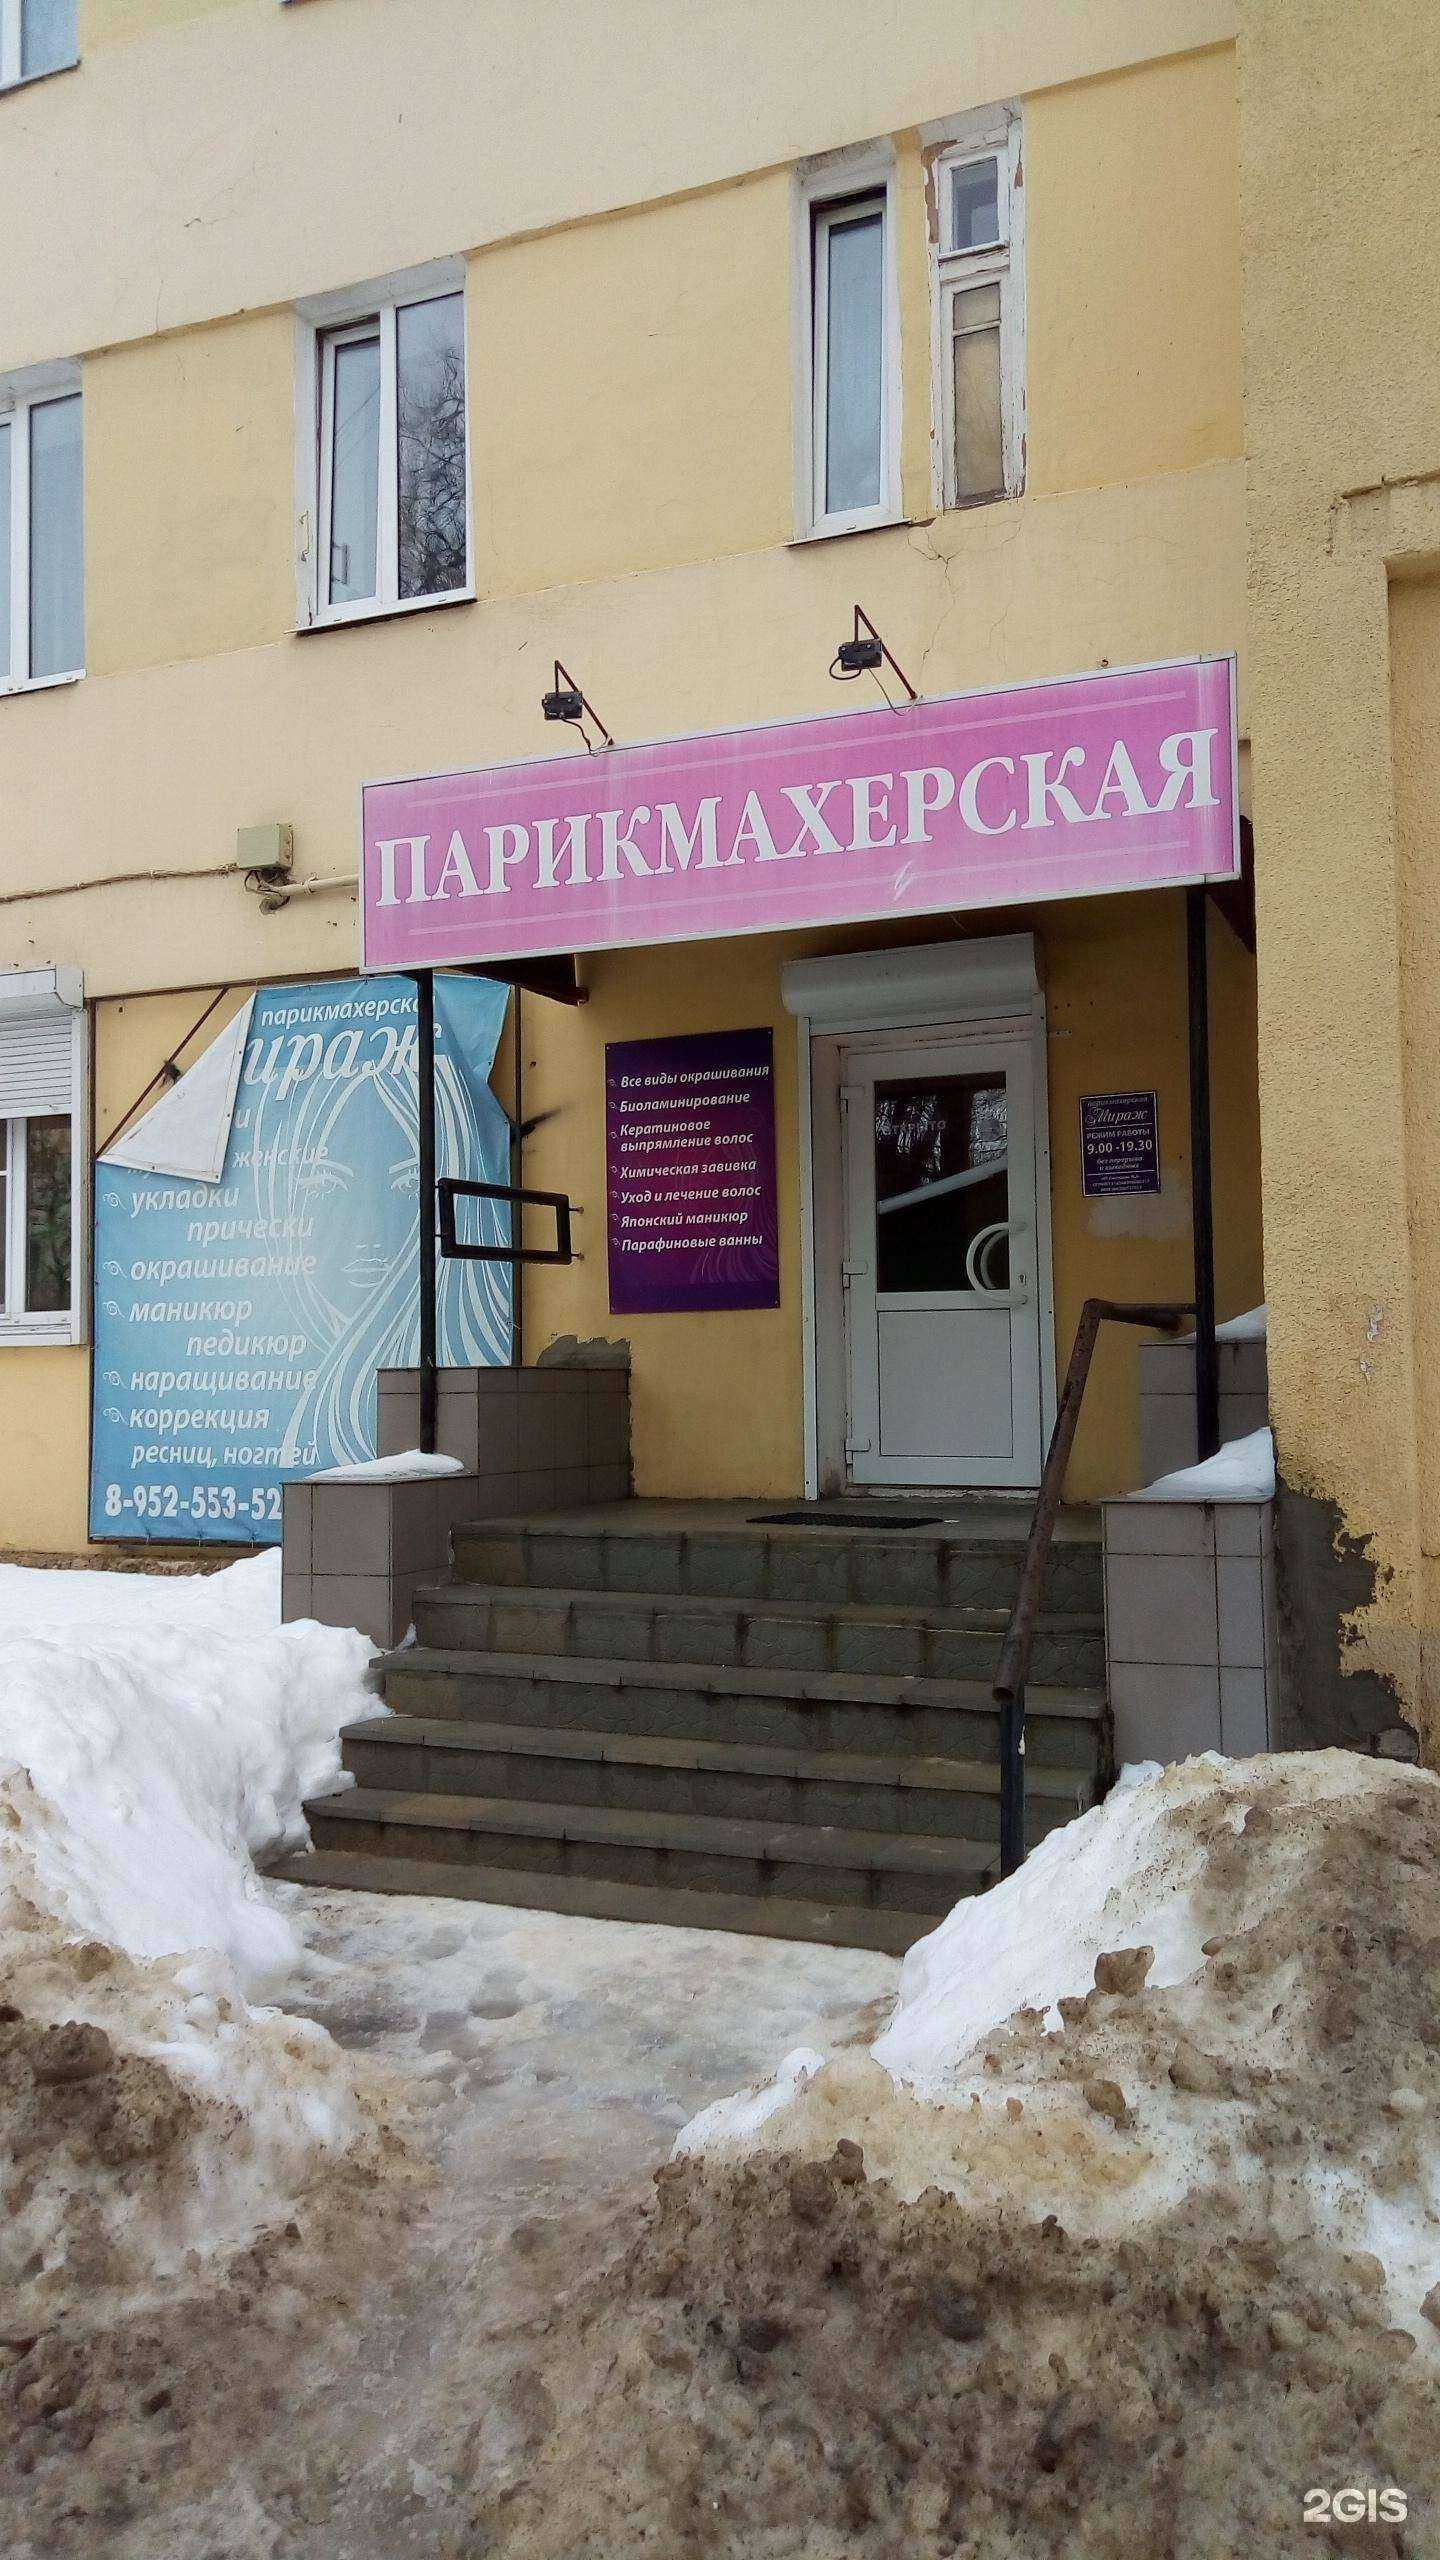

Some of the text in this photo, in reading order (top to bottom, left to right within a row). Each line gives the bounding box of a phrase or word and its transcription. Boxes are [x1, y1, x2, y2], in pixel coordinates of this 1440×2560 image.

[374, 728, 1219, 906] ПАРИКМАХЕРСКАЯ
[261, 996, 436, 1029] парикмахерск
[242, 1023, 443, 1100] ираж
[620, 1065, 770, 1088] Все виды окрашивания
[619, 1092, 751, 1113] Биоламинирование
[619, 1119, 711, 1137] Кератиновое
[1086, 1128, 1150, 1140] РЕЖИМ РАБОТЫ
[620, 1132, 754, 1153] выпрямление волос
[1087, 1142, 1113, 1155] 9.00
[232, 1145, 329, 1169] женские
[619, 1160, 757, 1179] Химическая завивка
[130, 1182, 241, 1218] укладки
[620, 1185, 762, 1204] Уход и лечение волос
[186, 1216, 314, 1247] прически
[620, 1210, 749, 1228] Японский маникюр
[621, 1233, 763, 1254] Парафиновые ванны
[130, 1253, 317, 1287] окрашивание
[128, 1299, 253, 1327] маникюр
[186, 1330, 308, 1361] педикюр
[130, 1368, 317, 1398] наращивание
[128, 1406, 270, 1436] коррекция
[130, 1442, 317, 1469] ресниц, ногтей
[104, 1483, 283, 1521] 8-952-553-52
